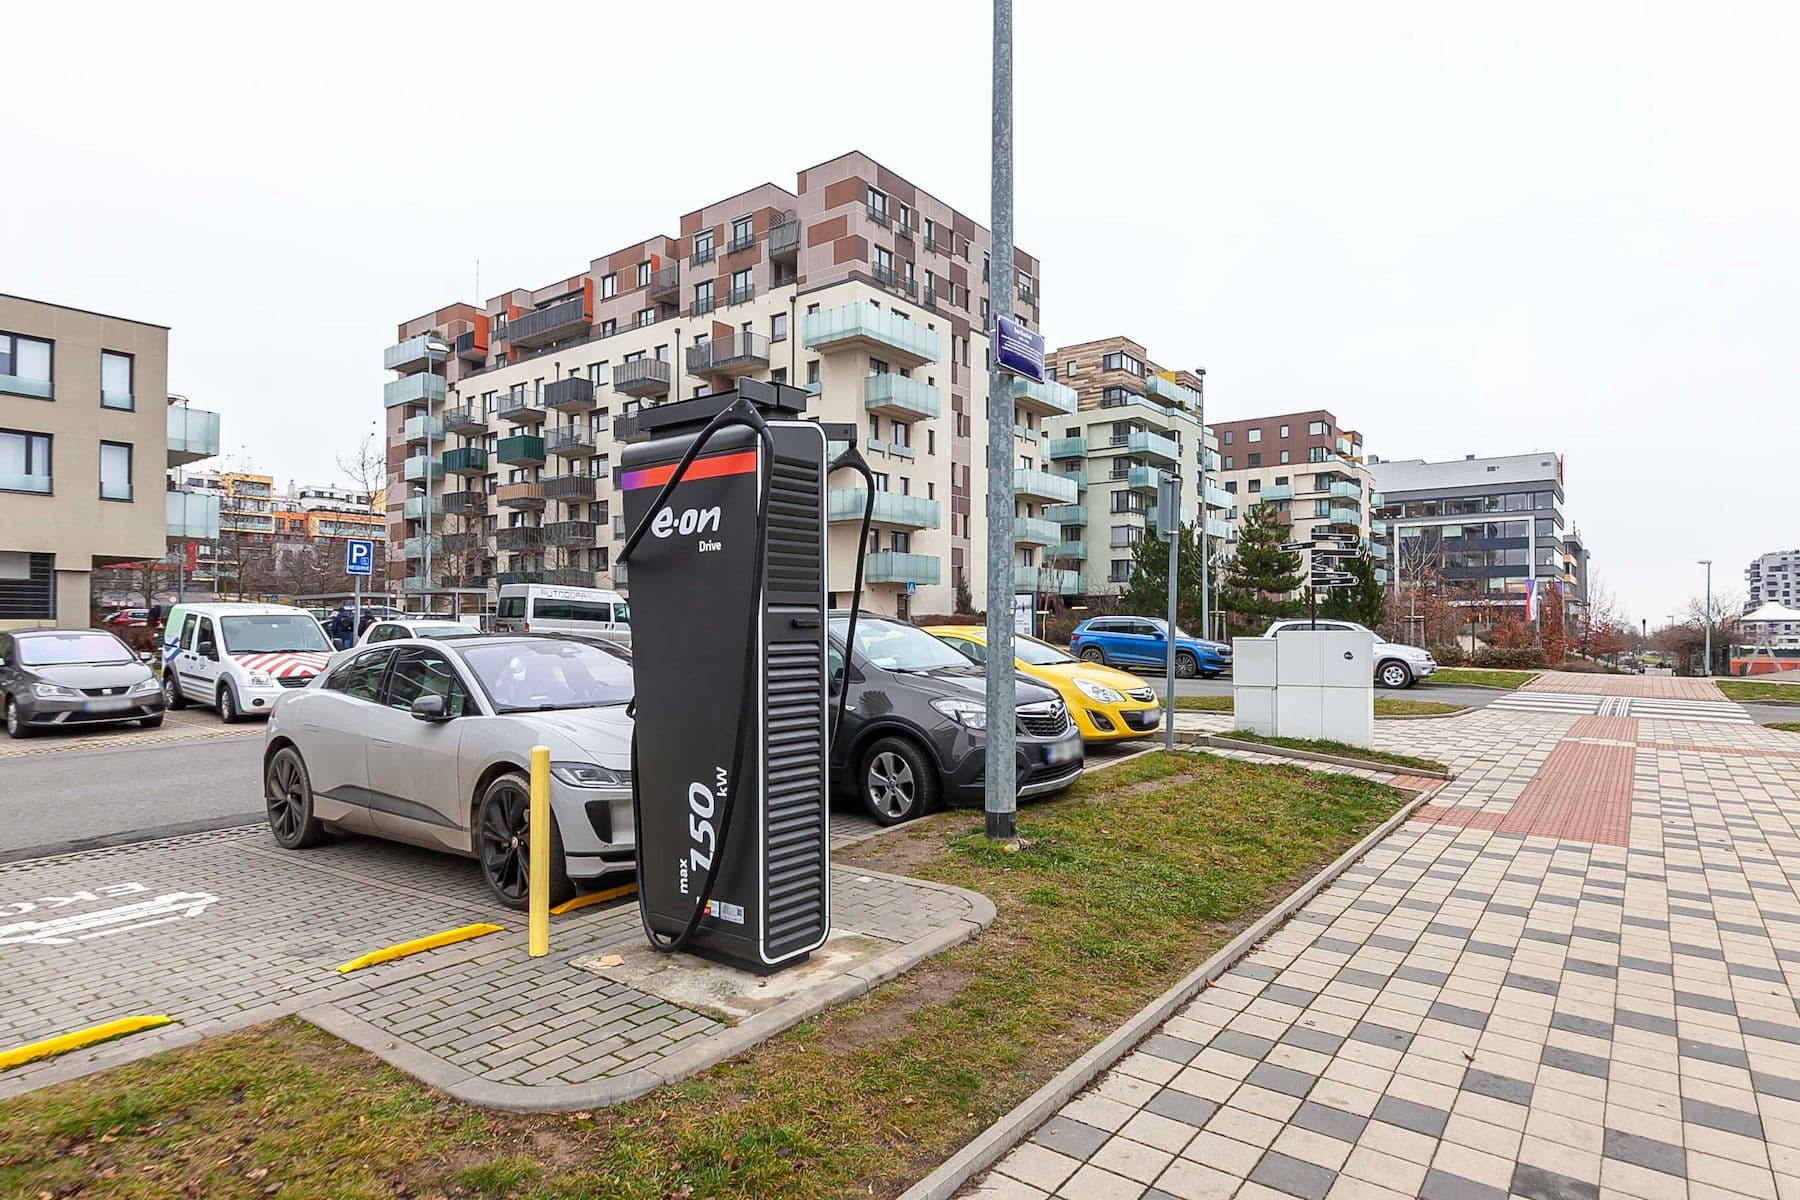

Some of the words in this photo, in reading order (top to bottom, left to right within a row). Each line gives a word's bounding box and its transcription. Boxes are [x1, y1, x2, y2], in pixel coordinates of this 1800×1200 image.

[352, 543, 368, 564] P
[698, 540, 722, 552] Drive
[679, 858, 689, 894] max
[688, 782, 716, 872] 150
[716, 766, 728, 797] kW
